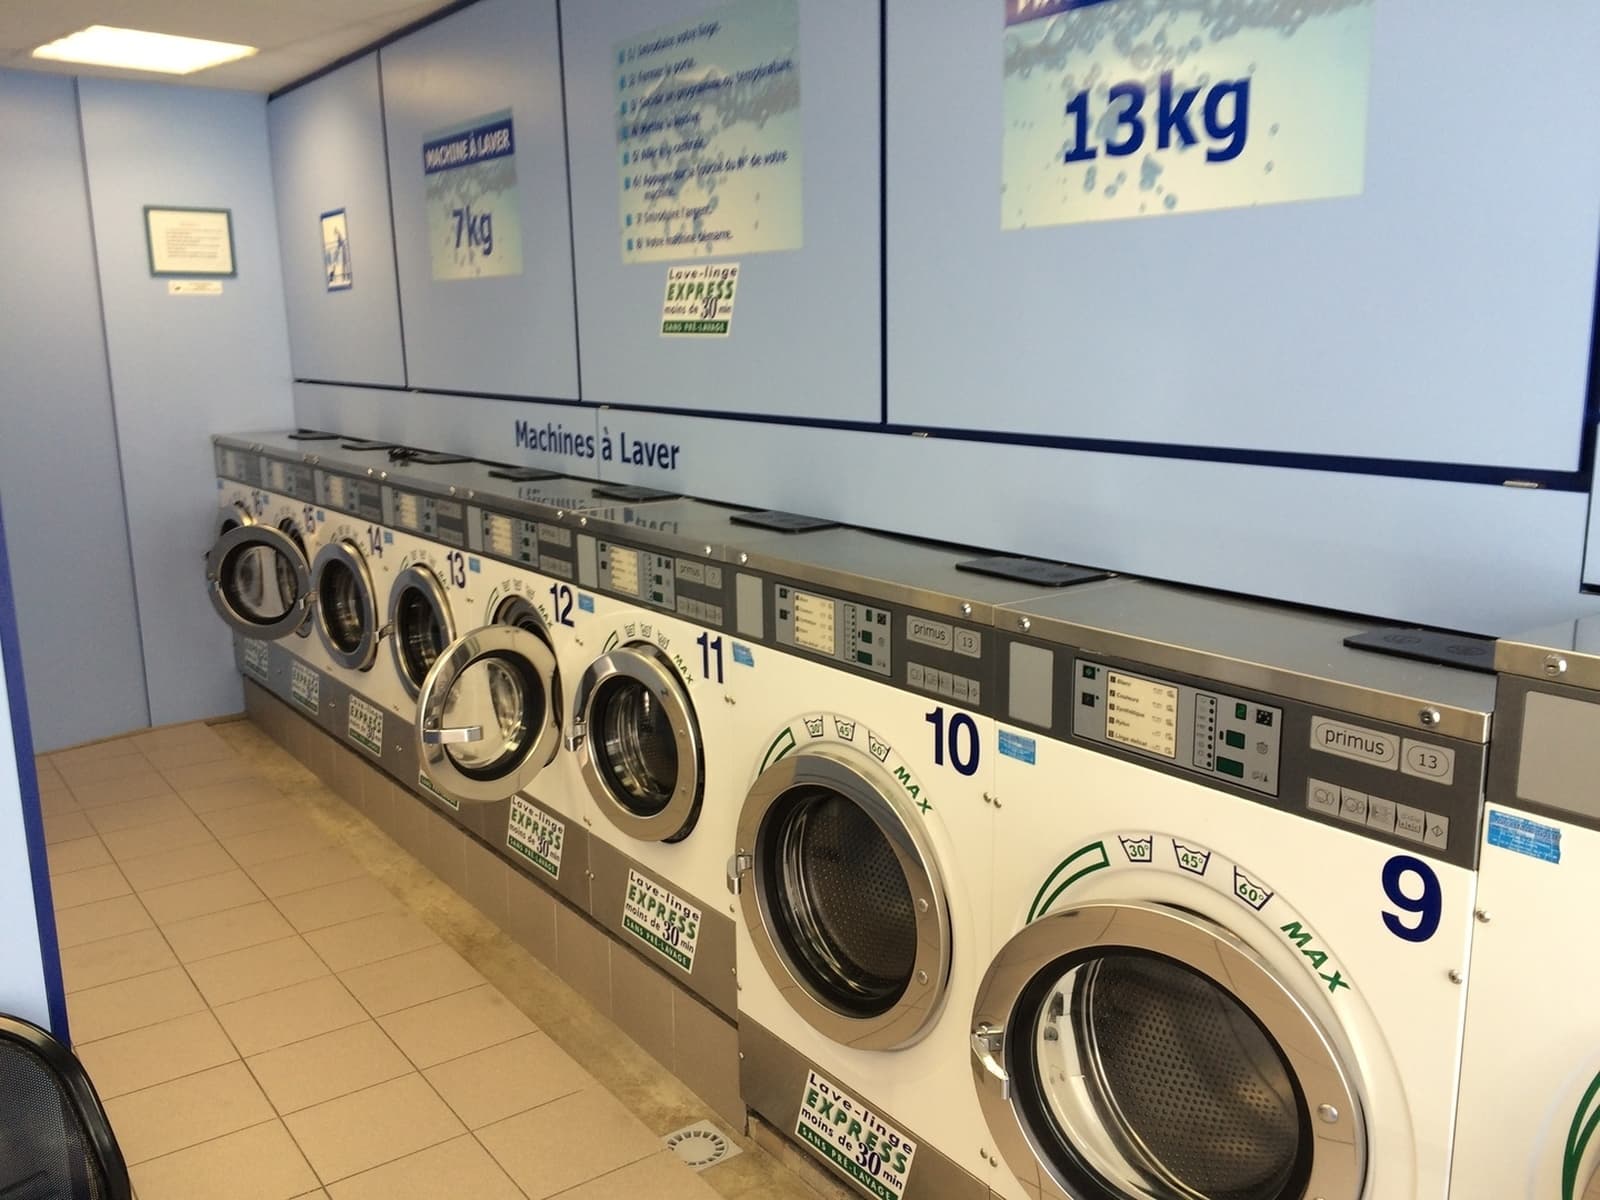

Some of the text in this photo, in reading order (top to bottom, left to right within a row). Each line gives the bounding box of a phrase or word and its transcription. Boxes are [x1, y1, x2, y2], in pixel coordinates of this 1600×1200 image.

[1063, 69, 1252, 164] 13kg
[425, 128, 511, 169] MACHINE À LAVER
[452, 205, 494, 256] 7kg
[667, 280, 734, 301] EXPRESS
[669, 265, 738, 280] Lave-linge
[700, 296, 719, 319] 30
[515, 420, 680, 470] Machines à Laver
[368, 525, 383, 558] 14
[446, 551, 466, 589] 13
[550, 583, 575, 628] 12
[913, 621, 974, 649] primus 13
[673, 655, 694, 684] MAX
[696, 631, 724, 684] 11
[925, 706, 980, 777] 10
[1324, 727, 1439, 770] primus 13
[893, 766, 934, 816] MAX
[511, 807, 561, 851] EXPRESS
[512, 796, 563, 834] Lave-linge
[537, 836, 550, 858] 30
[1129, 844, 1150, 858] 30°
[1181, 853, 1204, 870] 45°
[628, 884, 697, 940] EXPRESS
[630, 871, 699, 922] Lave-linge
[1238, 882, 1264, 903] 60°
[1381, 855, 1442, 943] 9
[626, 919, 644, 935] SANS
[626, 903, 694, 954] moins de 30 min
[1280, 920, 1352, 993] MAX
[806, 1087, 908, 1175] EXPRESS
[810, 1073, 913, 1155] Lave-linge
[801, 1108, 903, 1191] moins de 30 min
[802, 1126, 828, 1151] SANS
